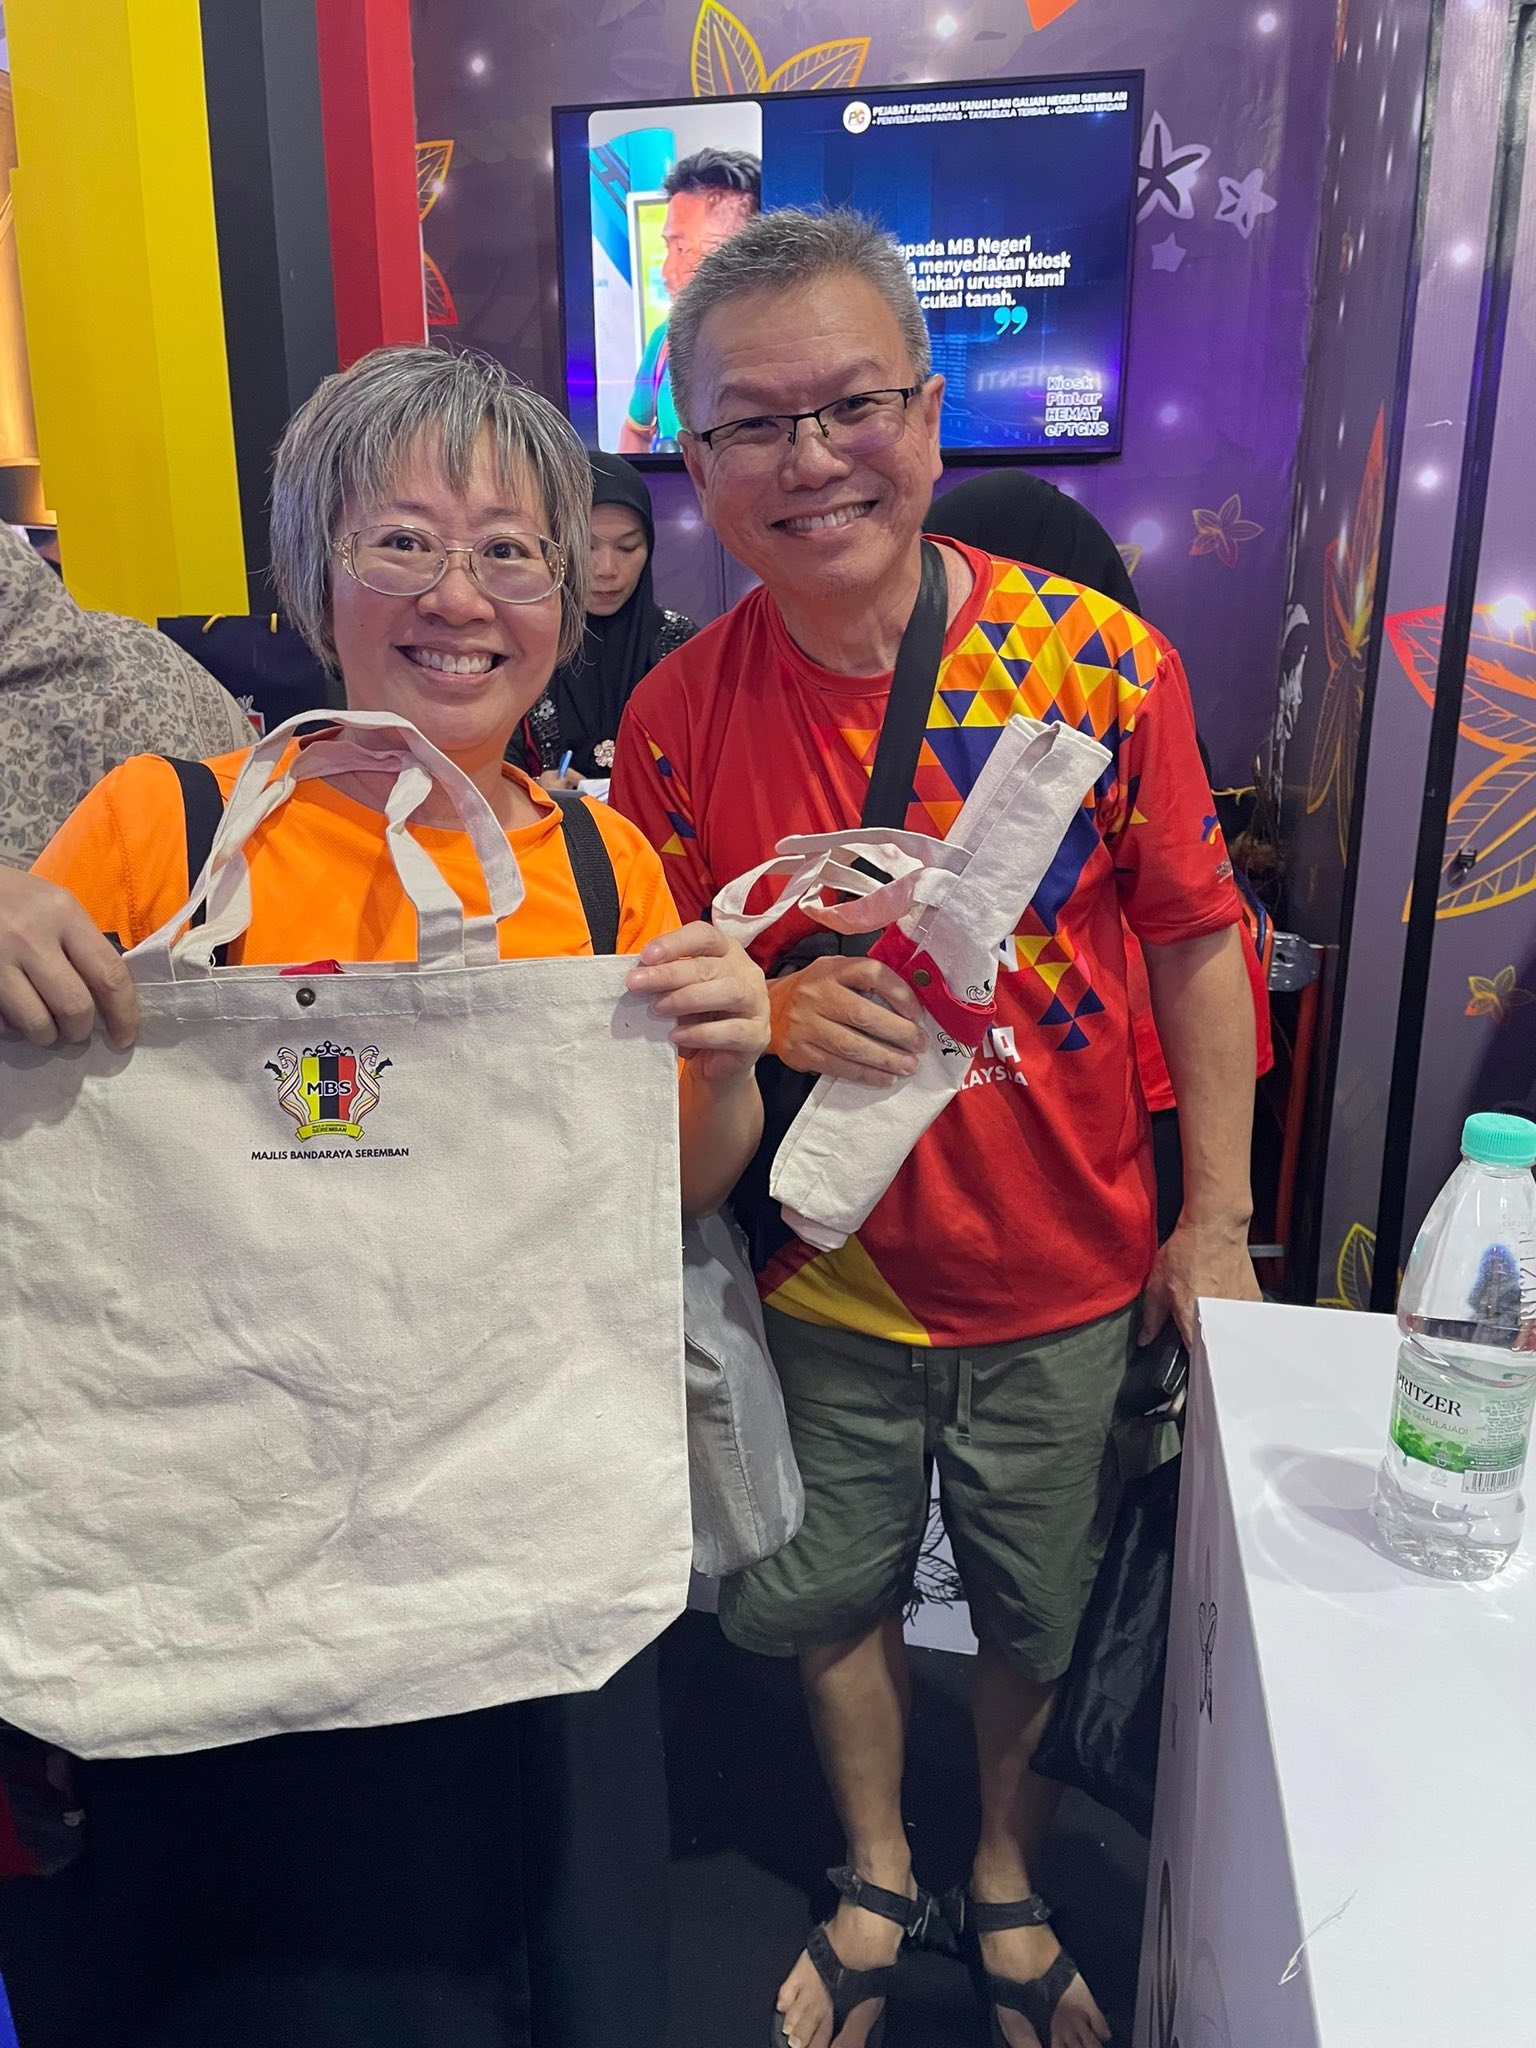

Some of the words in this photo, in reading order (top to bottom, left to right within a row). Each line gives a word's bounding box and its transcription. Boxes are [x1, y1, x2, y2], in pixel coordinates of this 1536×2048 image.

[872, 104, 910, 117] PEJABAT
[960, 99, 990, 112] TANAH
[992, 98, 1011, 110] DAN
[1012, 95, 1046, 108] GALIAN
[1047, 93, 1080, 106] NEGERI
[1081, 91, 1128, 103] SEMBILAN
[948, 238, 974, 255] MB
[978, 235, 1031, 257] Negeri
[919, 254, 1025, 276] menyediakan
[1028, 251, 1071, 269] kiosk
[967, 274, 1022, 290] urusan
[1025, 270, 1065, 287] kami
[921, 291, 963, 309] cukai
[965, 290, 1016, 307] tanah.
[1047, 376, 1093, 391] Kiosk
[1046, 391, 1102, 406] Pintar
[1045, 406, 1102, 421] HEMAT
[307, 1081, 351, 1097] MBS
[251, 1151, 288, 1160] MAJLIS
[290, 1149, 352, 1160] BANDARAYA
[355, 1148, 409, 1158] SEREMBAN
